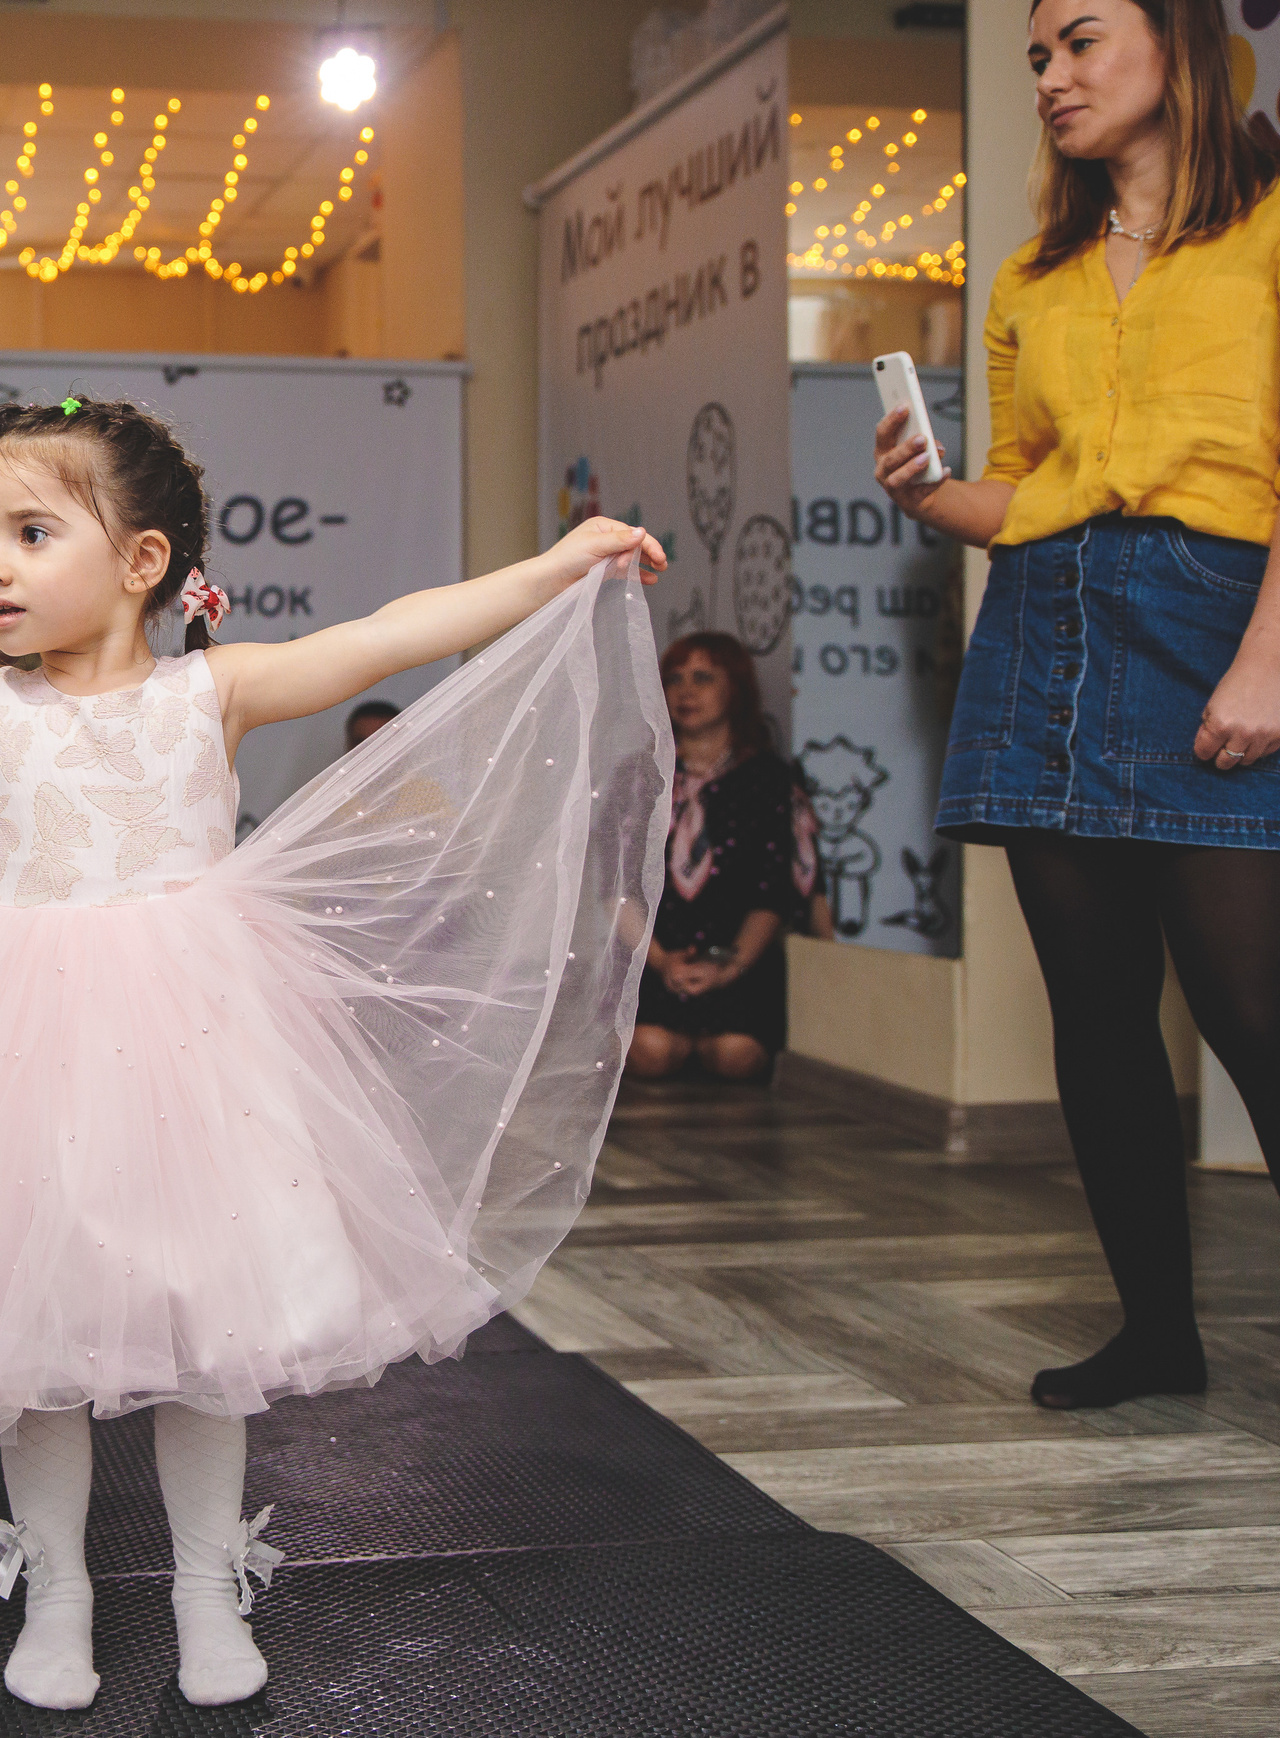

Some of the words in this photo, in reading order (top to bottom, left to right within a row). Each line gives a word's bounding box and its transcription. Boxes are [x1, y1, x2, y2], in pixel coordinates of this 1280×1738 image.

[561, 184, 627, 285] Мой
[634, 77, 780, 252] лучший
[576, 254, 728, 390] праздник
[219, 494, 348, 545] ое-
[226, 582, 313, 618] нок
